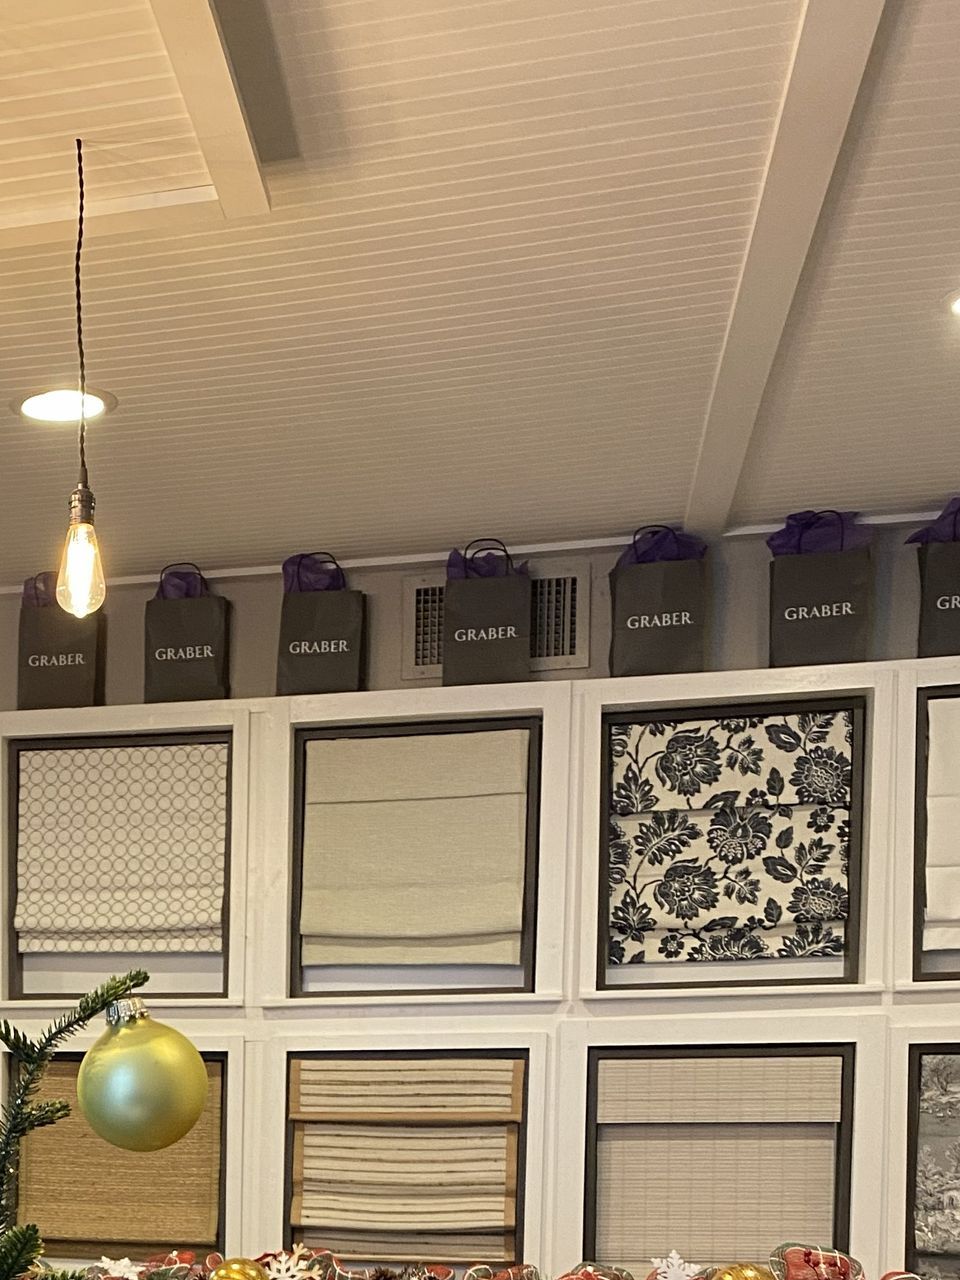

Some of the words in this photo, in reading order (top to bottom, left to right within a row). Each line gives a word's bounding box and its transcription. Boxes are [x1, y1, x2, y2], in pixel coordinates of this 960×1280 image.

[784, 601, 853, 621] GRABER
[626, 610, 693, 630] GRABER
[454, 625, 517, 642] GRABER
[155, 645, 213, 662] GRABER
[288, 639, 348, 655] GRABER
[28, 653, 84, 668] GRABER
